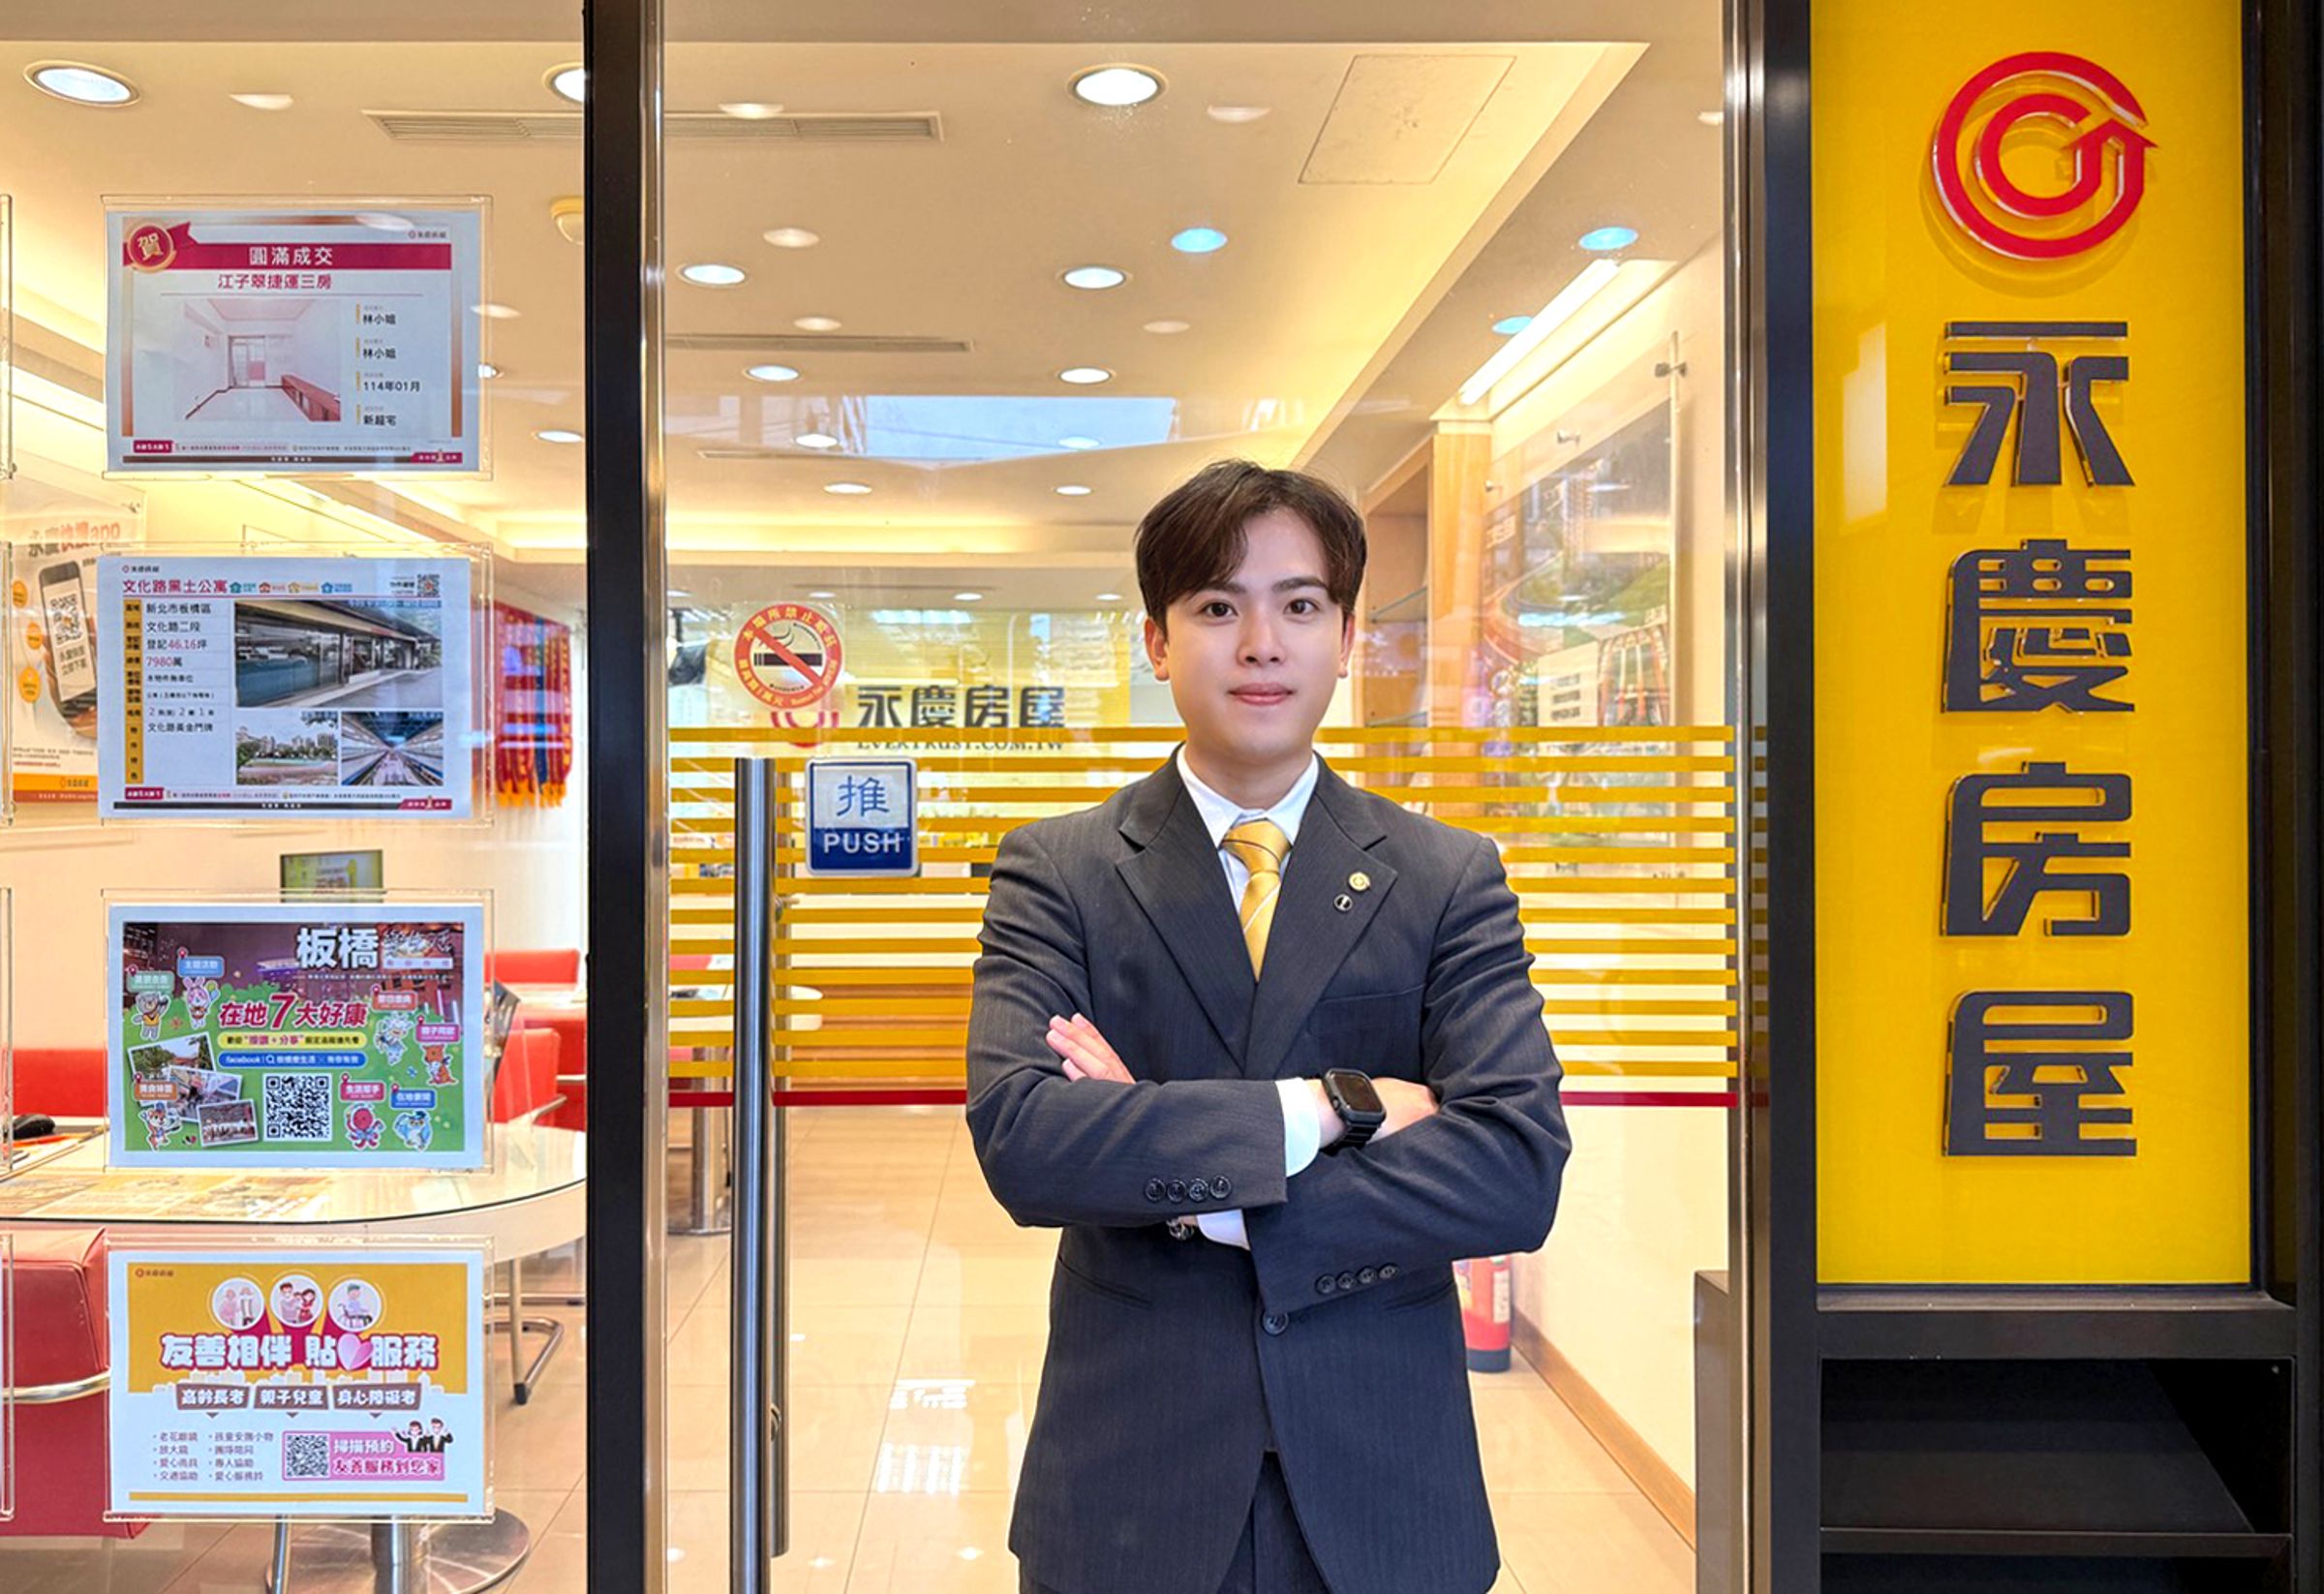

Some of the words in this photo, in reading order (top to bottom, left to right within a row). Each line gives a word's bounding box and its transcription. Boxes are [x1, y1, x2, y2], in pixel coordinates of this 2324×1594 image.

[137, 232, 163, 261] 賀
[249, 246, 334, 266] 圓滿成交
[218, 274, 332, 290] 江子翠捷運三房
[364, 381, 420, 392] 114年01月
[146, 603, 211, 614] 新北市板橋區
[146, 622, 201, 632] 文化路二段
[858, 685, 1065, 727] 永慶房屋
[1940, 321, 2136, 1157] 永慶房屋
[837, 776, 890, 818] 推
[823, 834, 902, 854] PUSH
[296, 927, 379, 969] 板橋
[219, 994, 368, 1029] 在地7大好康
[161, 1334, 292, 1368] 友善相伴
[305, 1335, 337, 1367] 貼
[371, 1335, 437, 1368] 服務
[181, 1390, 245, 1405] 高齡長者
[260, 1390, 323, 1405] 親子兒童
[337, 1390, 416, 1405] 身心障礙者
[335, 1458, 441, 1474] 友善服務到您家
